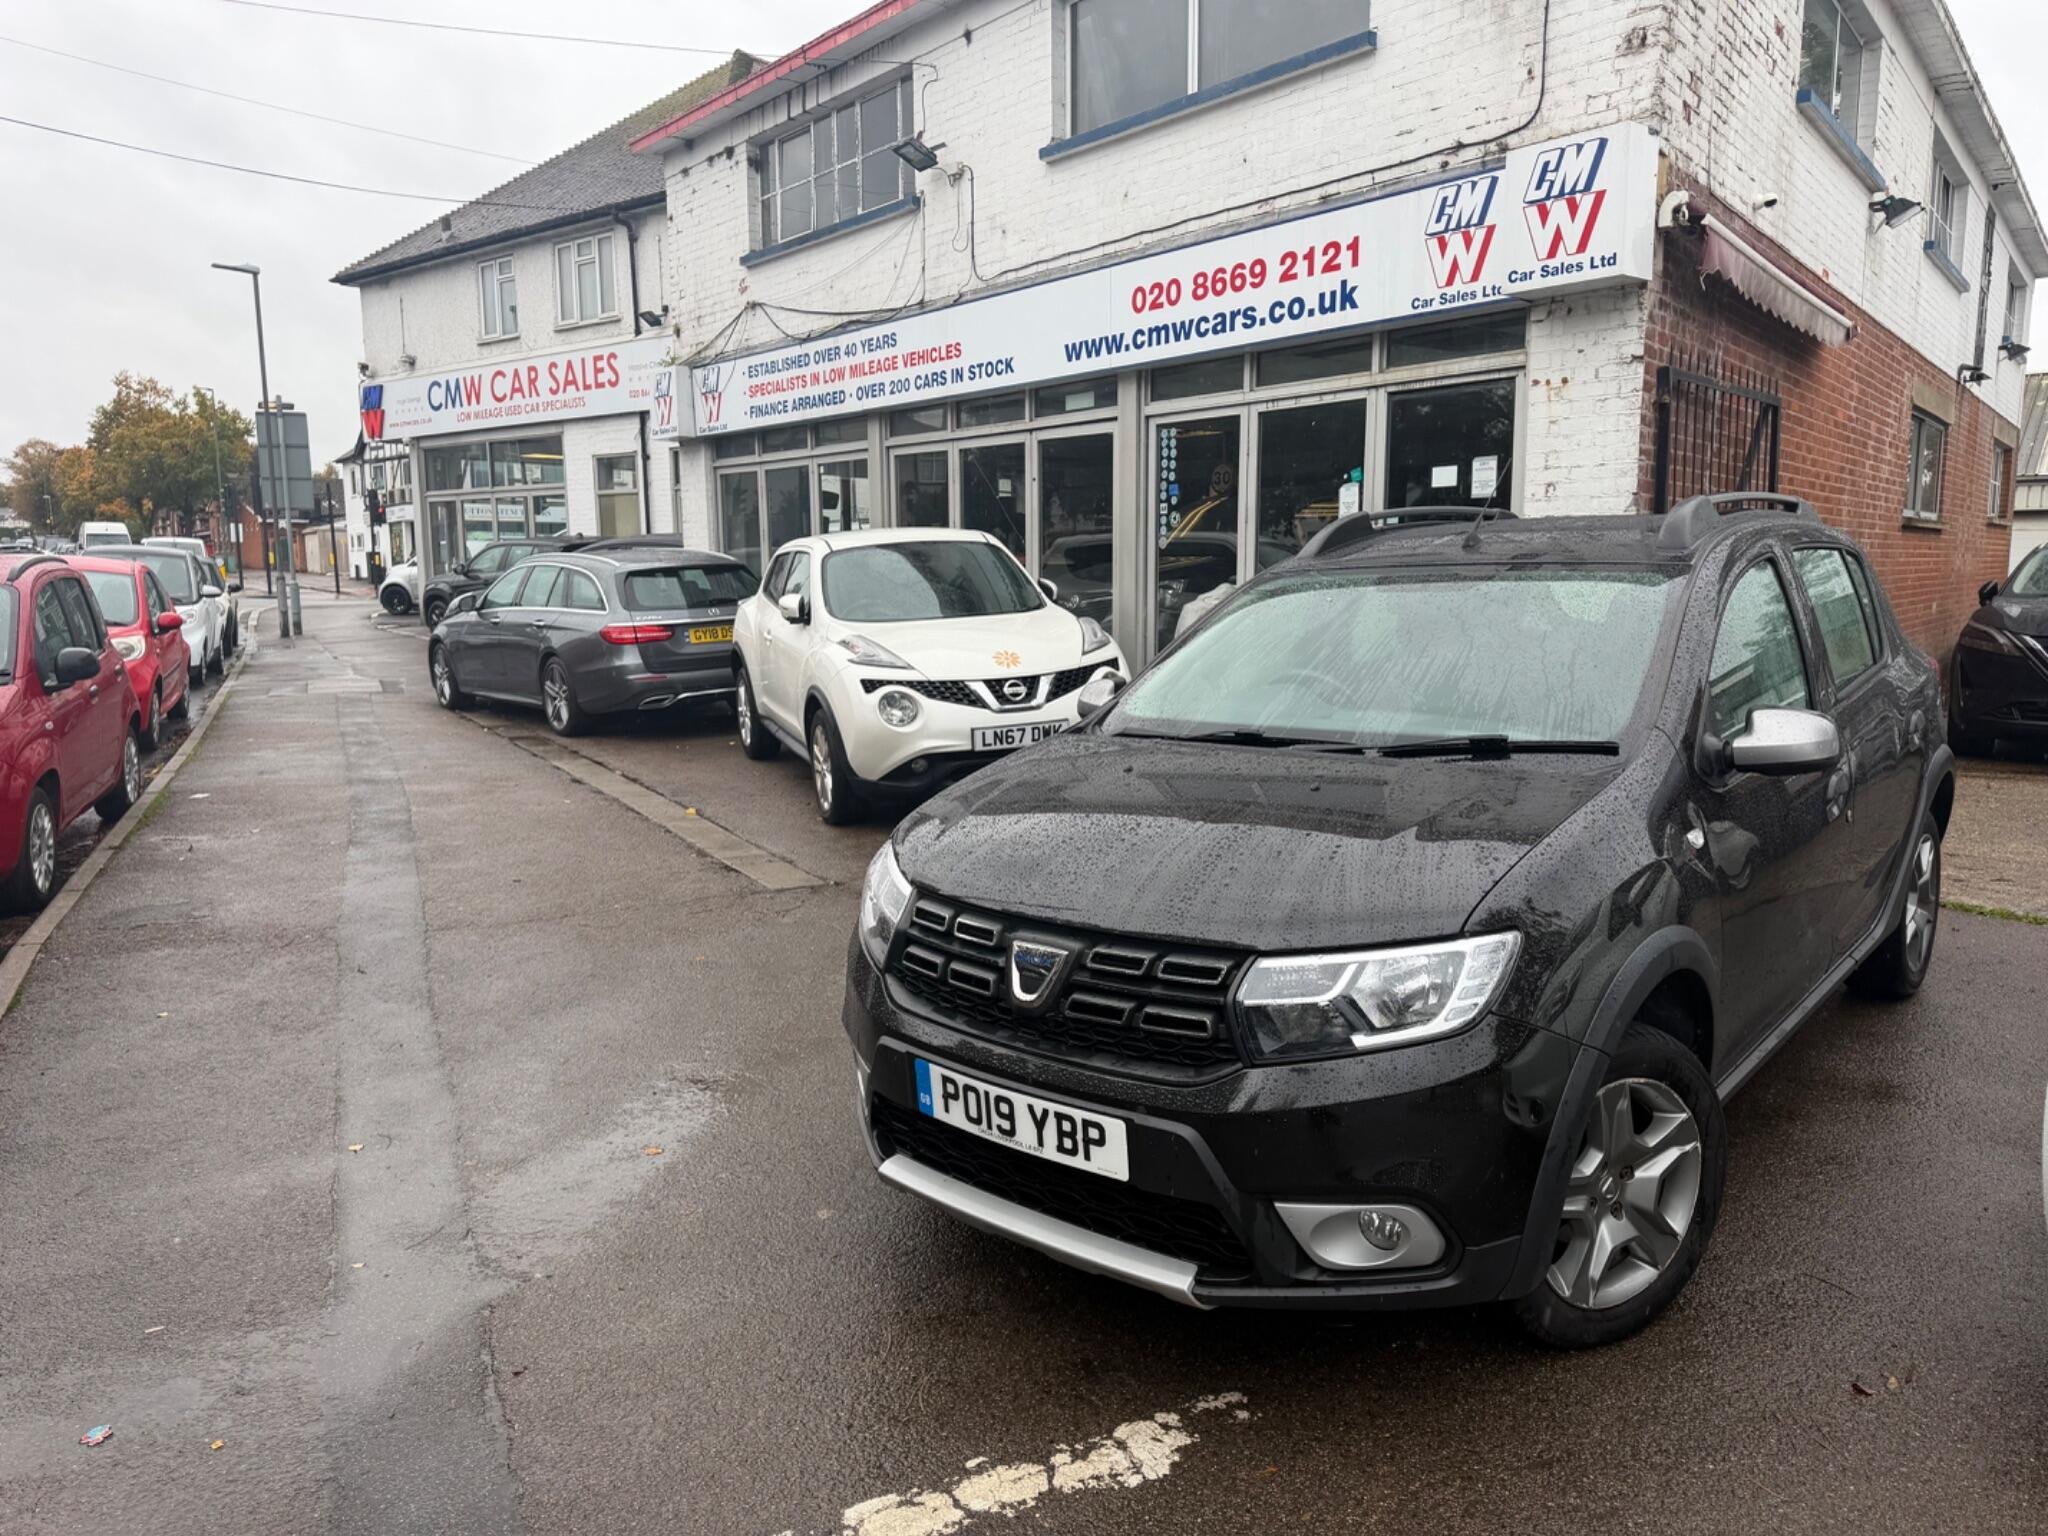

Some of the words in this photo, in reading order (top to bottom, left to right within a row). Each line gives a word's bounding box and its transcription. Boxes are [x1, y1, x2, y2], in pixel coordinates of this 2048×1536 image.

[1131, 274, 1183, 314] 020
[1192, 260, 1268, 302] 8669
[1279, 235, 1362, 282] 2121
[1508, 268, 1535, 285] Car
[1540, 258, 1585, 279] Sales
[1590, 252, 1618, 271] Ltd
[1065, 278, 1359, 363] www.cmwcars.co.uk
[1411, 294, 1436, 311] Car
[1440, 288, 1478, 308] Sales
[747, 354, 811, 379] ESTABLISHED
[813, 347, 842, 366] OVER
[844, 344, 860, 359] 40
[860, 332, 898, 356] YEARS
[748, 373, 809, 399] SPECIALISTS
[810, 369, 821, 387] IN
[822, 365, 848, 386] LOW
[849, 355, 901, 380] MILEAGE
[902, 342, 963, 368] VEHICLES
[428, 374, 483, 413] CMW
[490, 366, 540, 404] CAR
[547, 352, 621, 396] SALES
[749, 398, 790, 420] FINANCE
[791, 389, 846, 411] ARRANGED
[856, 382, 887, 403] OVER
[889, 378, 912, 397] 200
[914, 370, 948, 392] CARS
[950, 367, 965, 386] IN
[967, 357, 1015, 382] STOCK
[456, 410, 472, 424] LOW
[473, 406, 503, 422] MILEAGE
[504, 402, 525, 418] USED
[525, 400, 541, 415] CAR
[542, 396, 587, 413] SPECIALISTS
[694, 628, 720, 641] GY18
[982, 728, 1026, 748] LN67
[941, 1074, 1016, 1138] PO19
[1027, 1102, 1107, 1163] YBP
